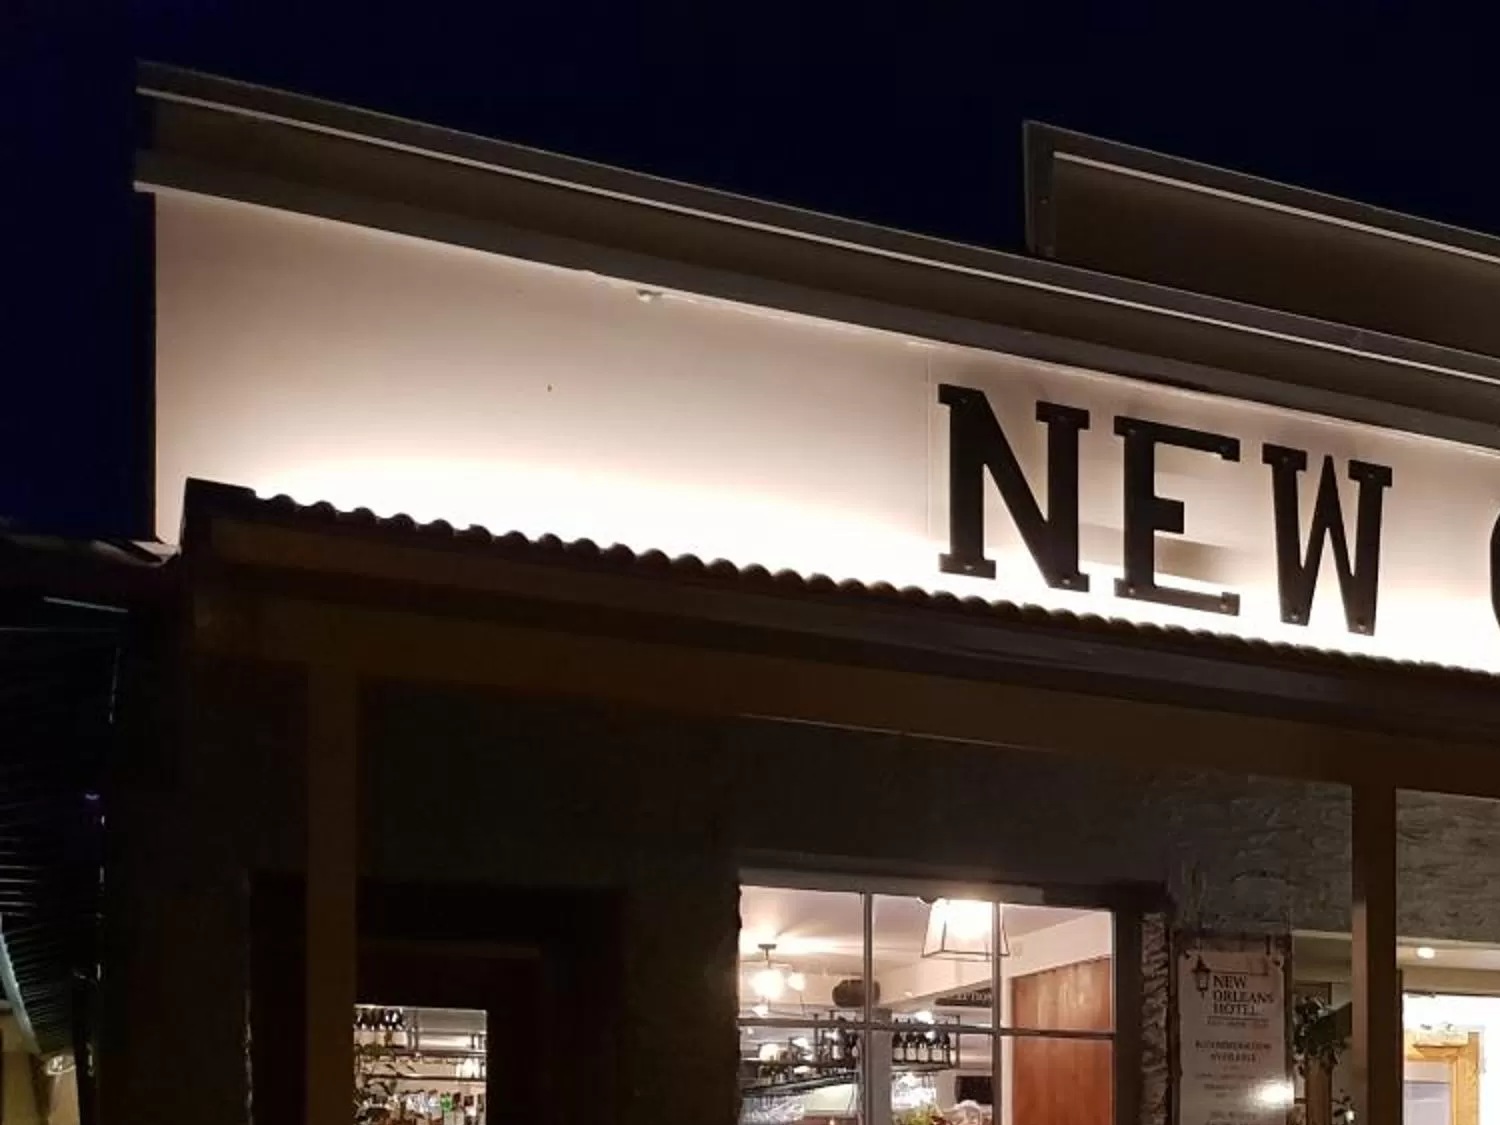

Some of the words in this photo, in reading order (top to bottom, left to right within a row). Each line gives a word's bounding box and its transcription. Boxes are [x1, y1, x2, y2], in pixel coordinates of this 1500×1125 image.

[938, 383, 1392, 636] NEW
[1213, 975, 1249, 989] NEW
[1213, 990, 1275, 1004] ORLEANS
[1213, 1003, 1260, 1016] HOTEL
